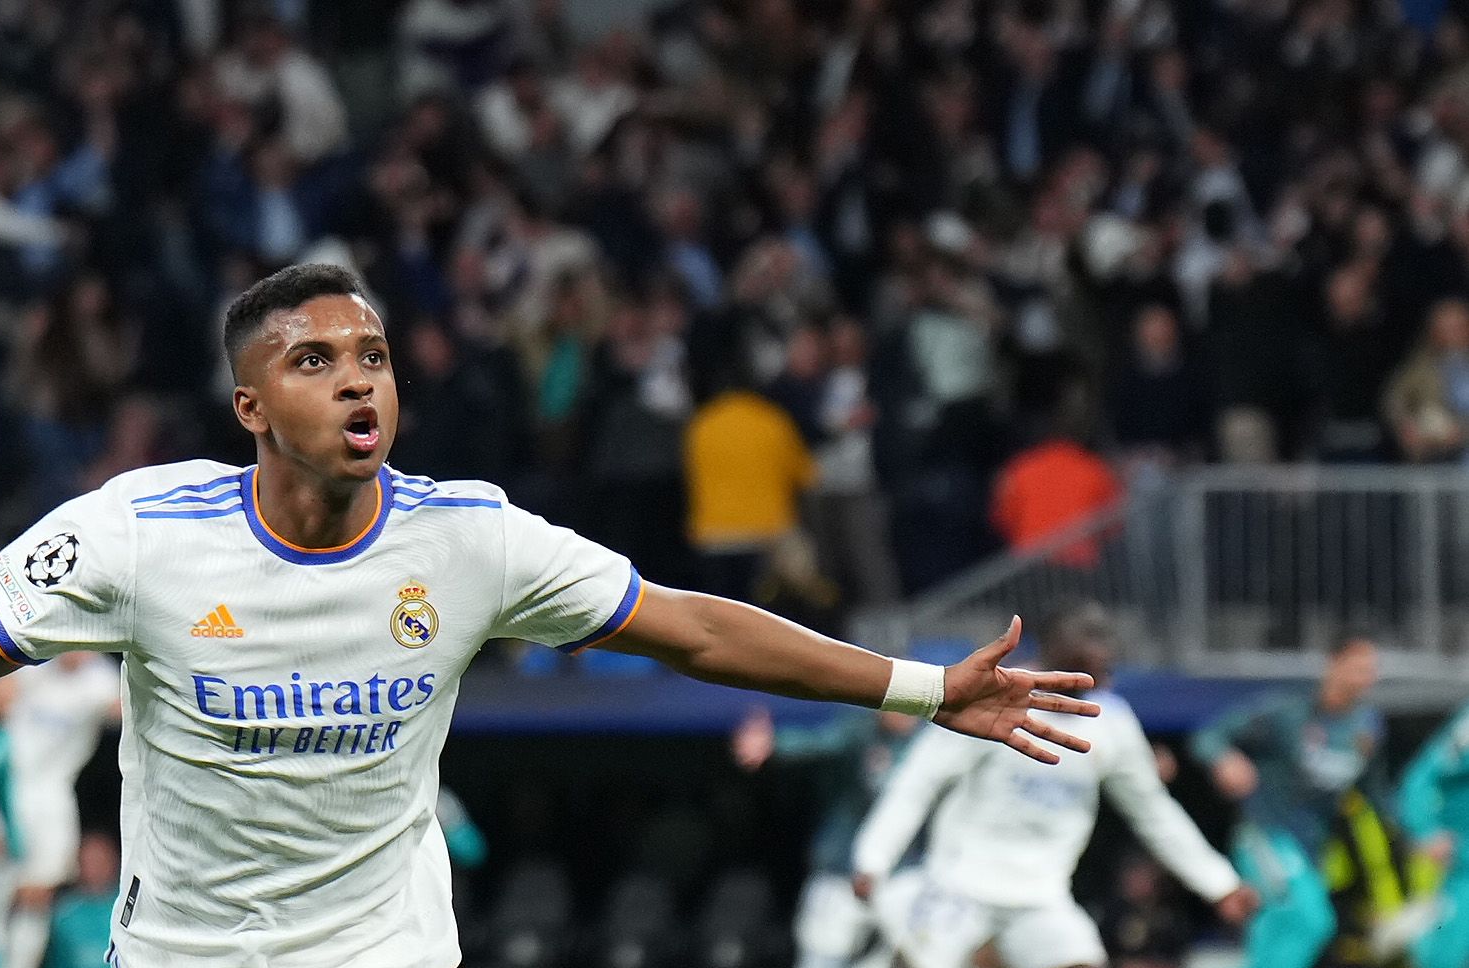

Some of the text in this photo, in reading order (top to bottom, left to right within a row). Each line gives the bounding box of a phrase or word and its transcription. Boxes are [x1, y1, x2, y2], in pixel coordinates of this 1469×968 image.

[191, 624, 243, 638] adidas
[191, 672, 435, 720] Emirates
[233, 720, 401, 754] FLY BETTER
